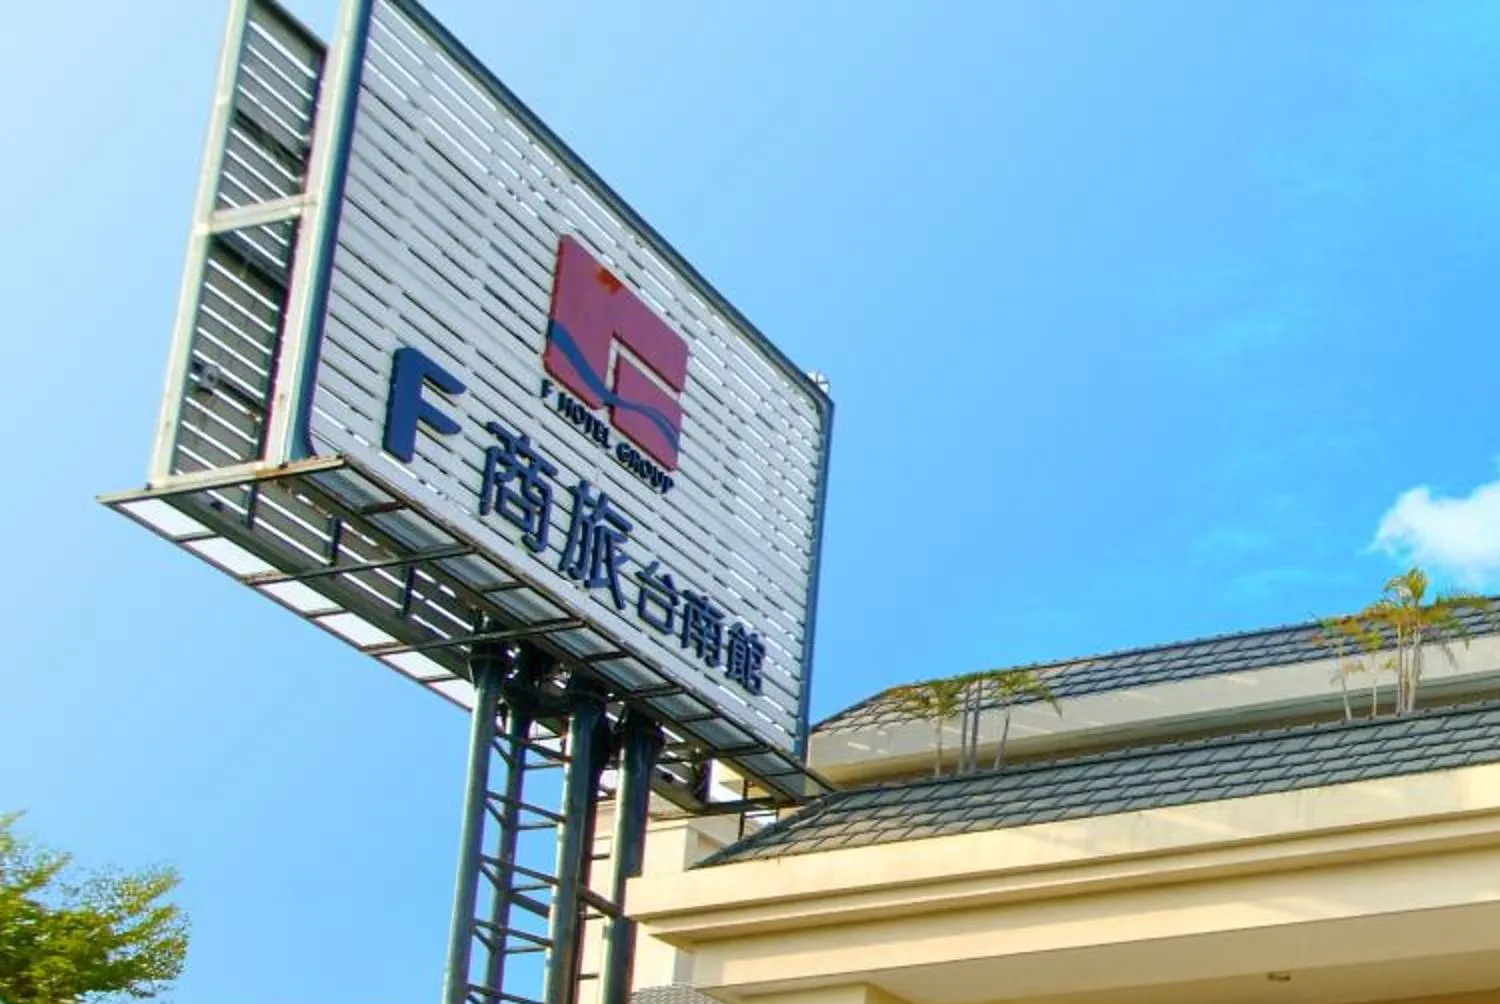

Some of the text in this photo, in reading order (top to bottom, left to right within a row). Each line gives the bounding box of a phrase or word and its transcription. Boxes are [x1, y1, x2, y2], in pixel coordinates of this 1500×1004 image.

[382, 346, 466, 465] F
[541, 379, 675, 494] F HOTEL GROUP
